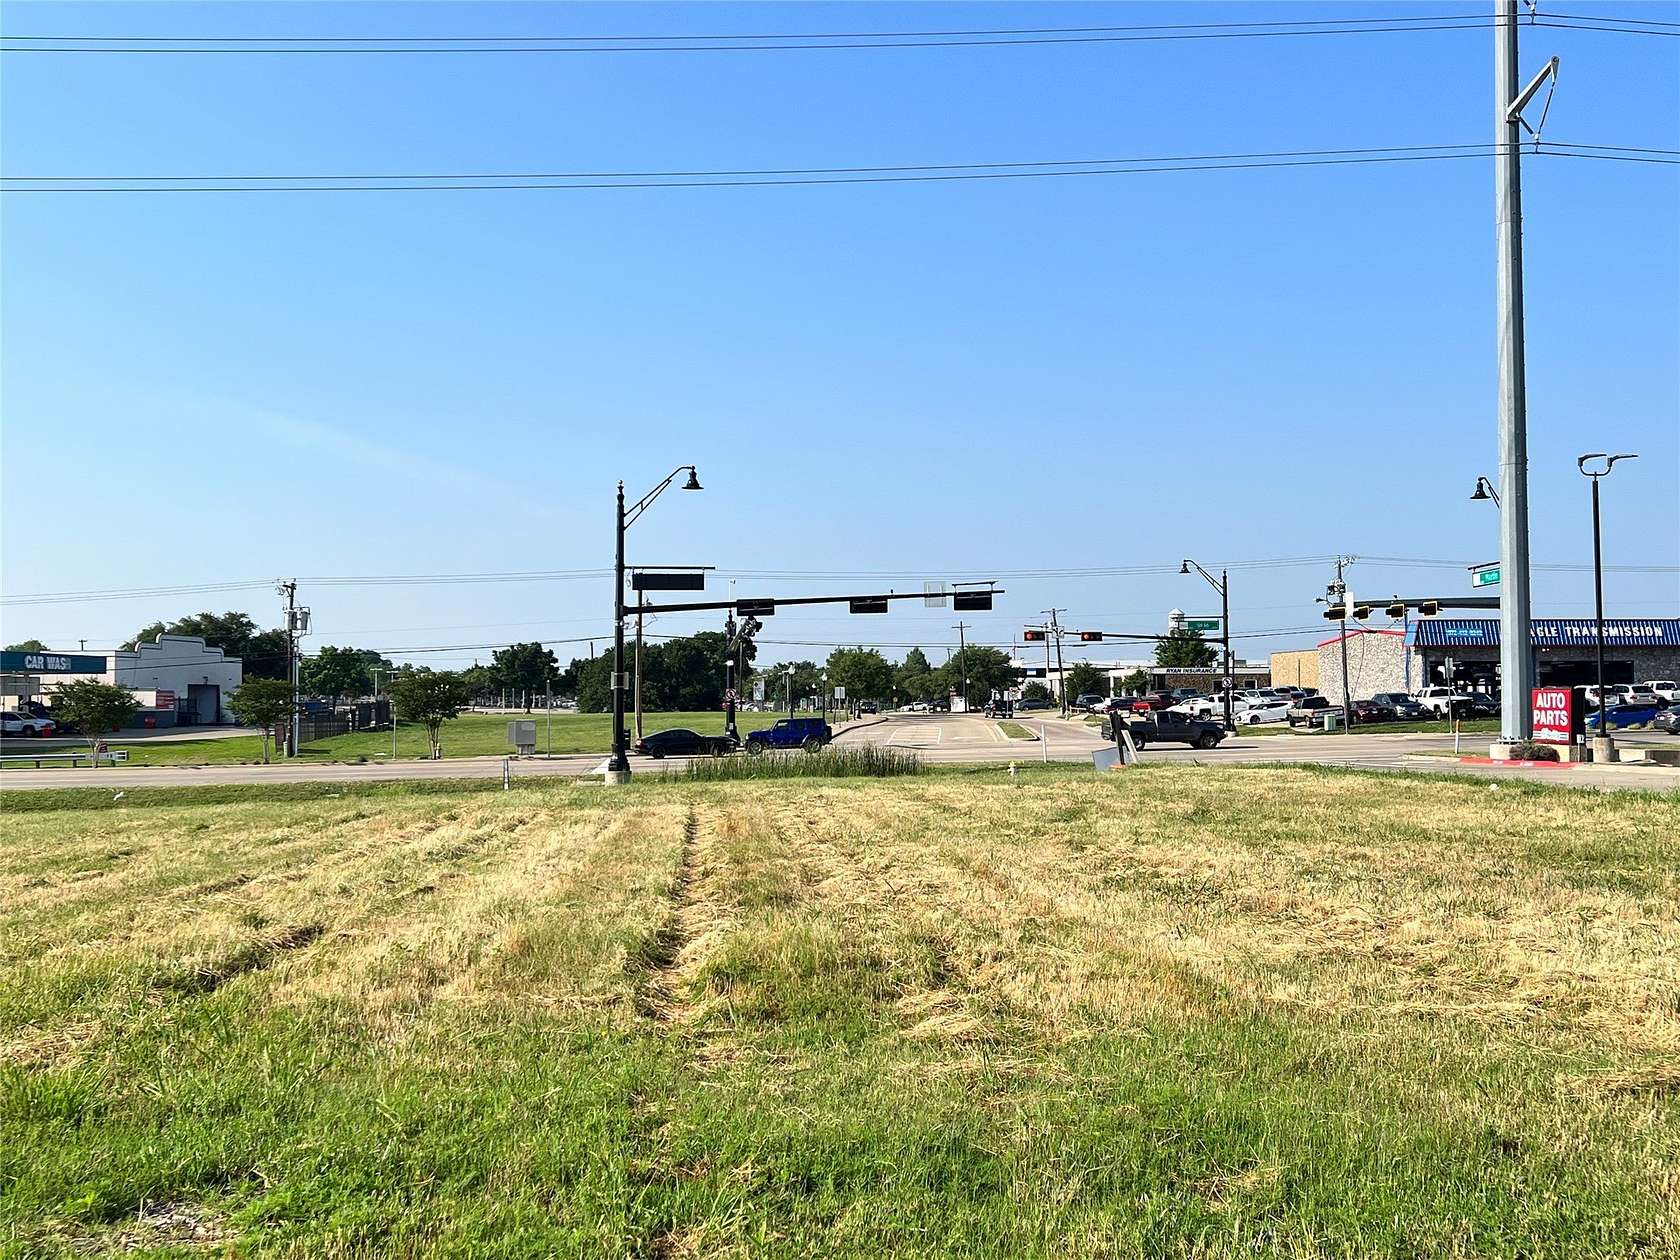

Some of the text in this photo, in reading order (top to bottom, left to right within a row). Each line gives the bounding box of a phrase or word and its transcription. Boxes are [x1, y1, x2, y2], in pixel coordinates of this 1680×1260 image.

[24, 655, 44, 669] CAR
[1536, 692, 1566, 709] AUTO
[1533, 709, 1569, 726] PARTS
